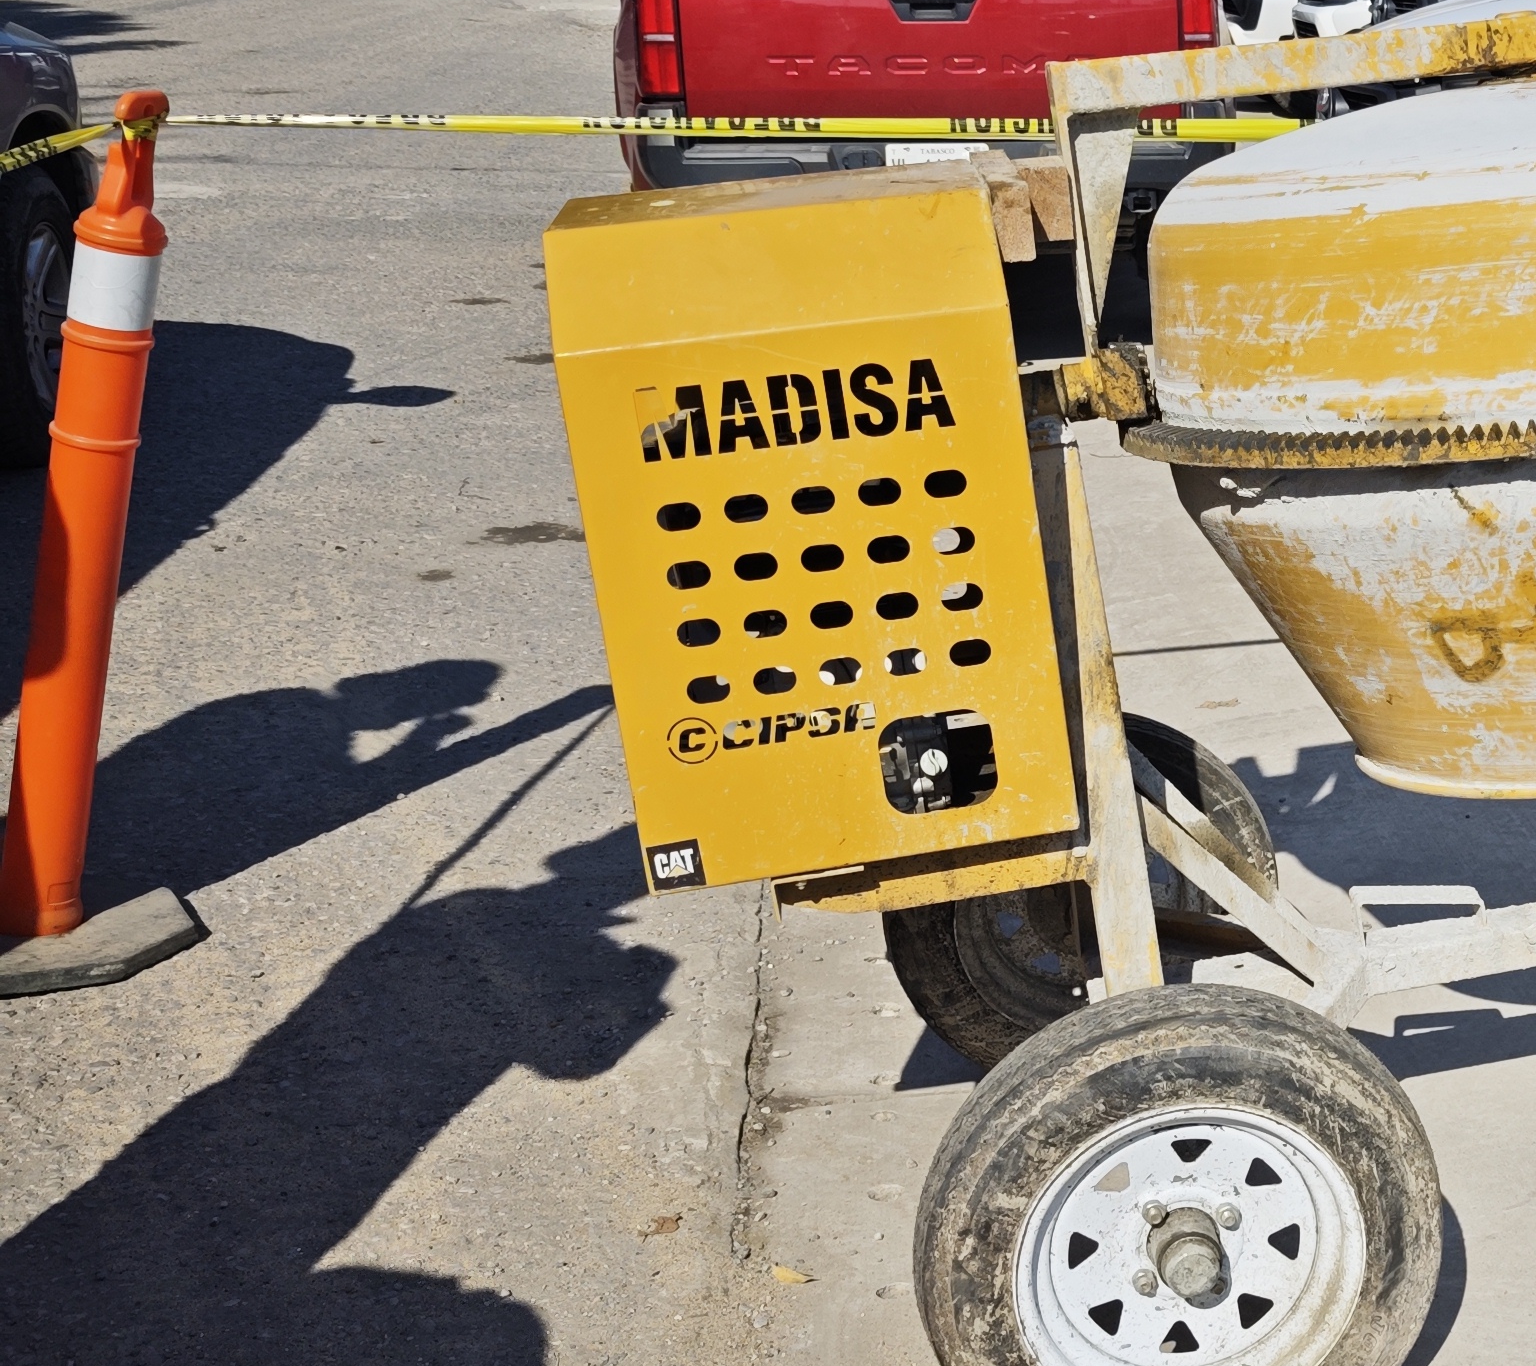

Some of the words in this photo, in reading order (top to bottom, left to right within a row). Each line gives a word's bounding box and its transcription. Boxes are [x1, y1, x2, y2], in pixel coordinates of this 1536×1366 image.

[766, 55, 1097, 75] TACOM
[920, 147, 956, 155] TABASCO
[633, 358, 956, 463] MADISA
[722, 701, 876, 751] CIPSA
[653, 847, 695, 880] CAT
